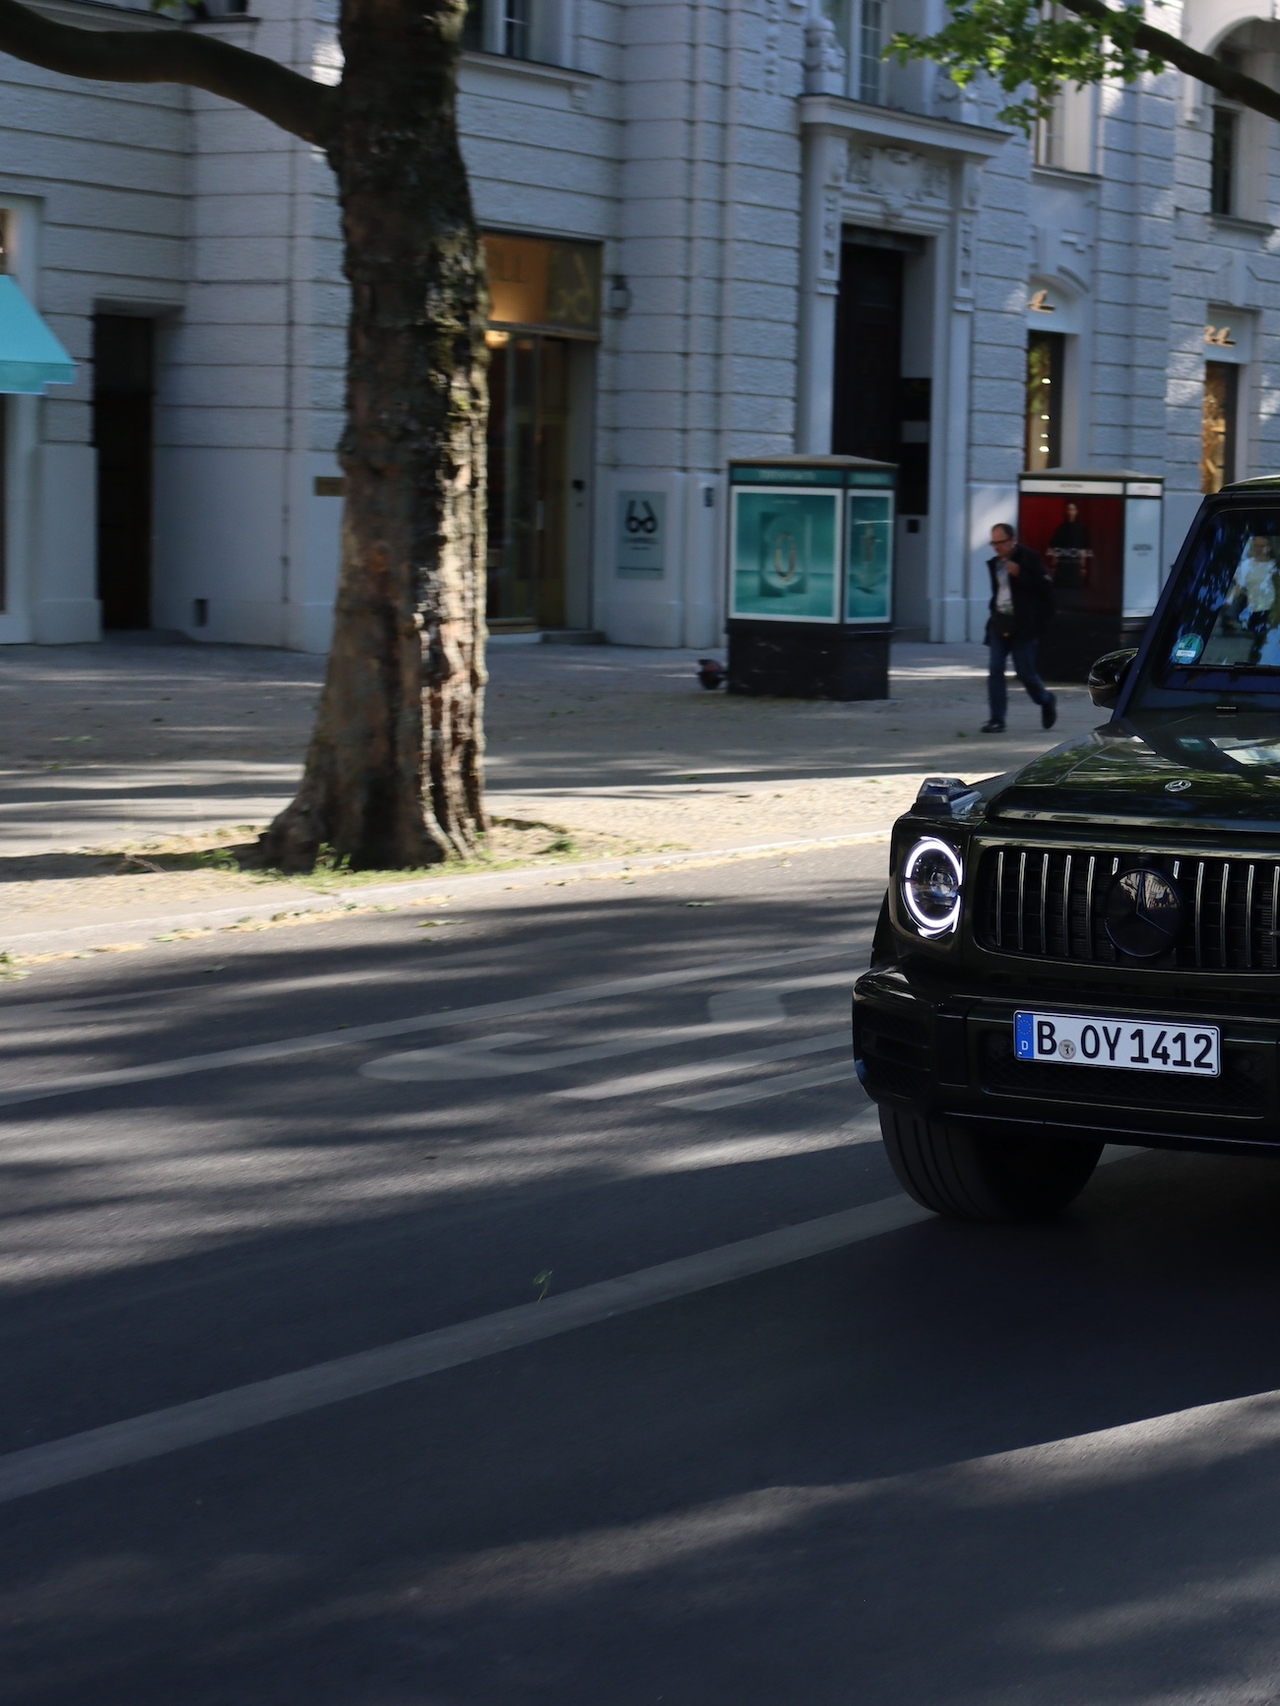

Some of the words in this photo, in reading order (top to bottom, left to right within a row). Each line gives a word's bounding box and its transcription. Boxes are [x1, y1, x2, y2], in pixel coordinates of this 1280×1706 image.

[1185, 637, 1194, 649] 4
[1021, 1041, 1029, 1051] D
[1037, 1020, 1058, 1056] B
[1080, 1024, 1122, 1061] OY
[1130, 1029, 1213, 1069] 1412
